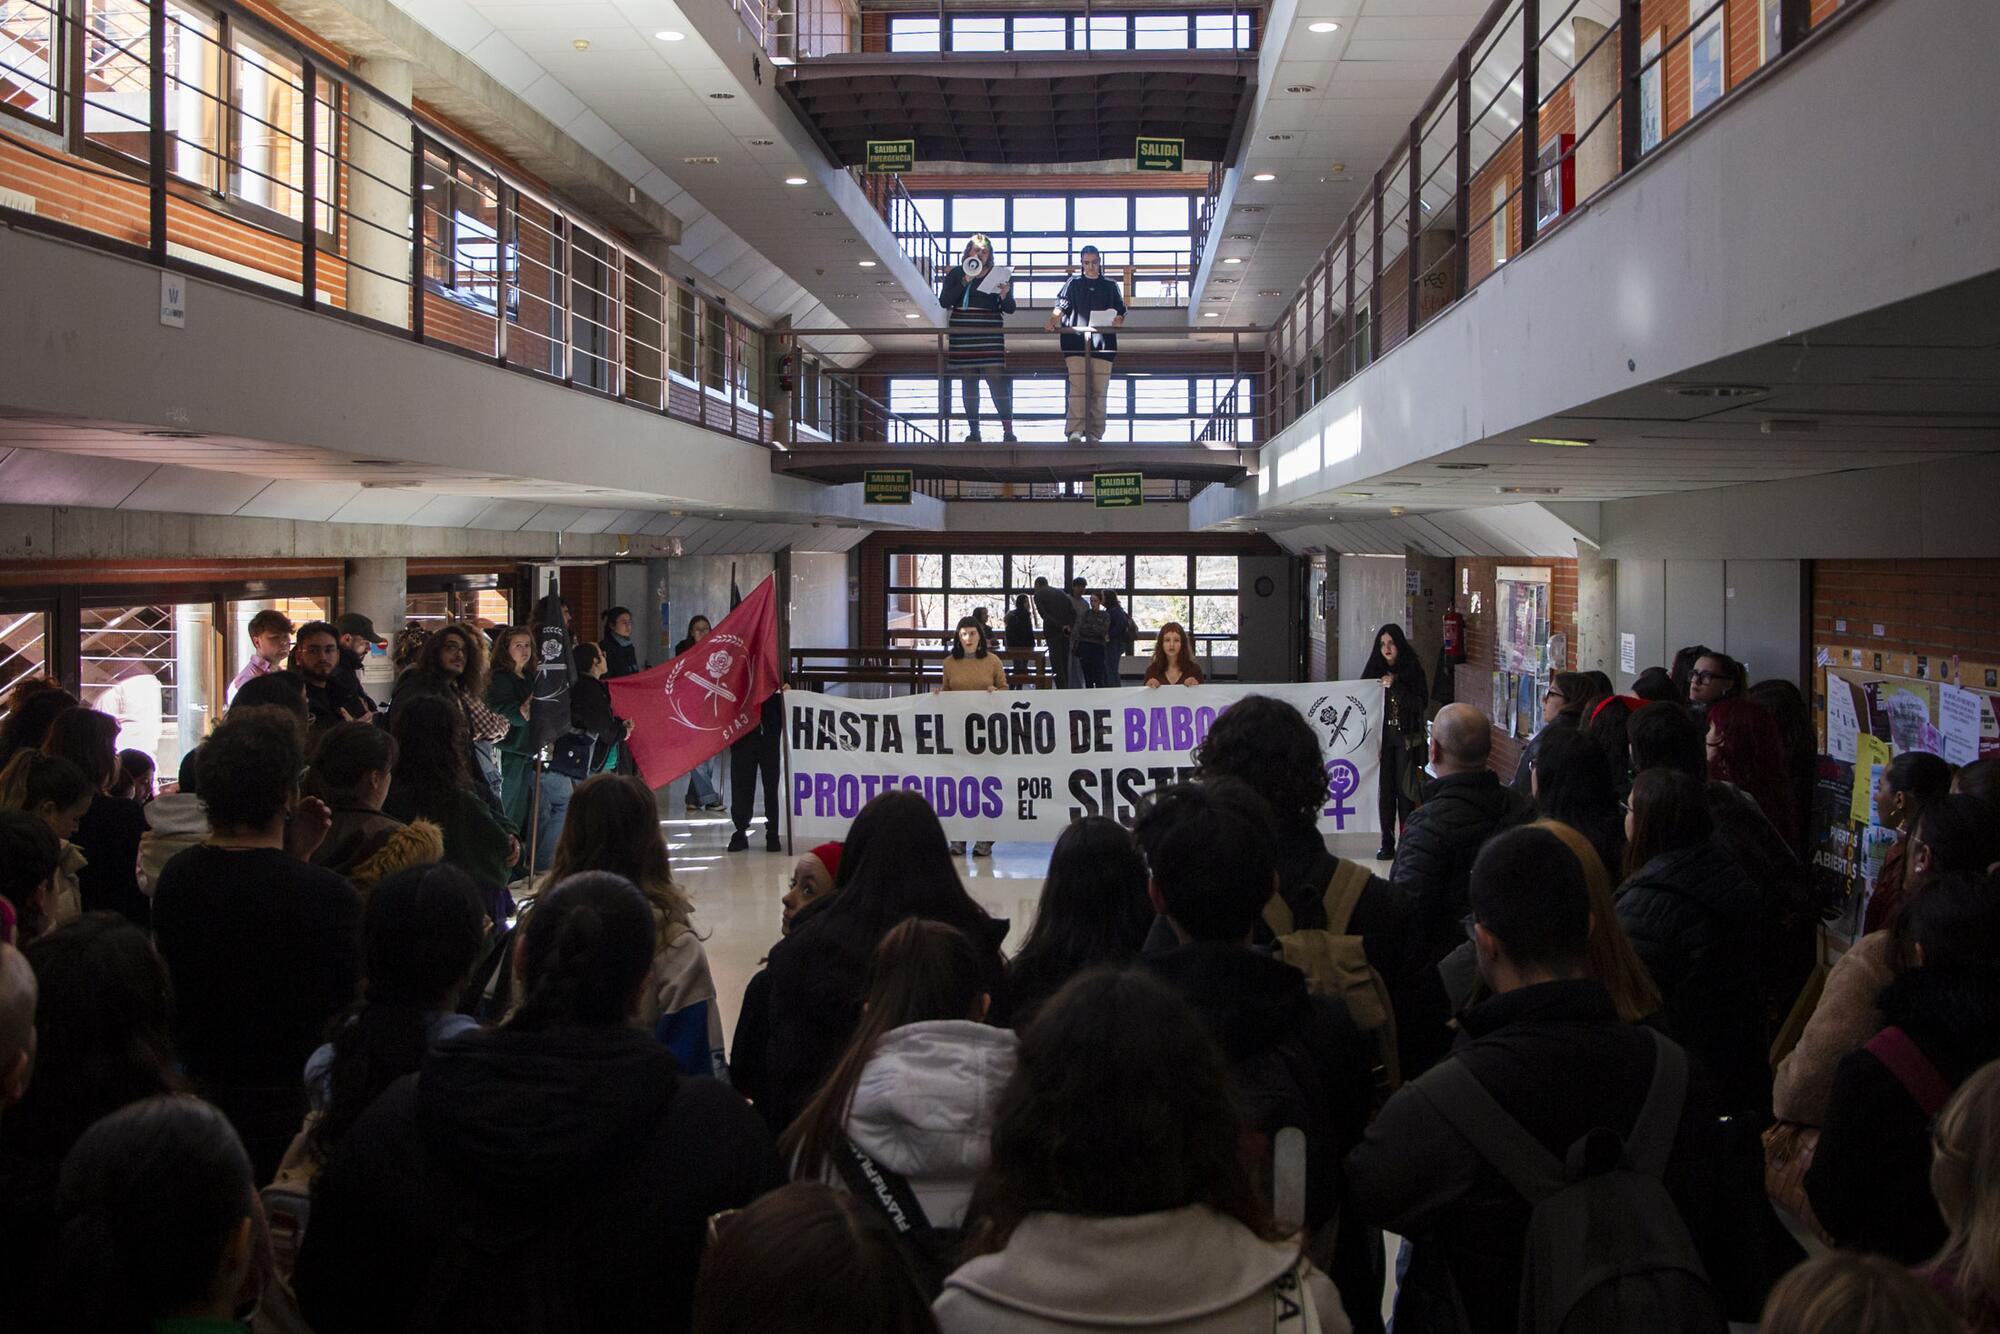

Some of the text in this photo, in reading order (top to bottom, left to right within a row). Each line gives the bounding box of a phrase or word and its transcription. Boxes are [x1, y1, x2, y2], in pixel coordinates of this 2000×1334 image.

[874, 144, 908, 153] SALIDA DE
[1140, 143, 1179, 157] SALIDA
[871, 474, 904, 483] SALIDA DE
[1100, 477, 1135, 487] SALIDA DE
[867, 483, 910, 493] EMERGENCIA
[1096, 487, 1140, 497] EMERGENCIA
[793, 706, 903, 753] HASTA
[915, 714, 953, 755] EL
[965, 701, 1056, 755] COÑO
[1069, 709, 1113, 754] DE
[1018, 777, 1052, 799] POR
[1018, 800, 1037, 820] EL
[1812, 849, 1857, 880] ABIERTAS
